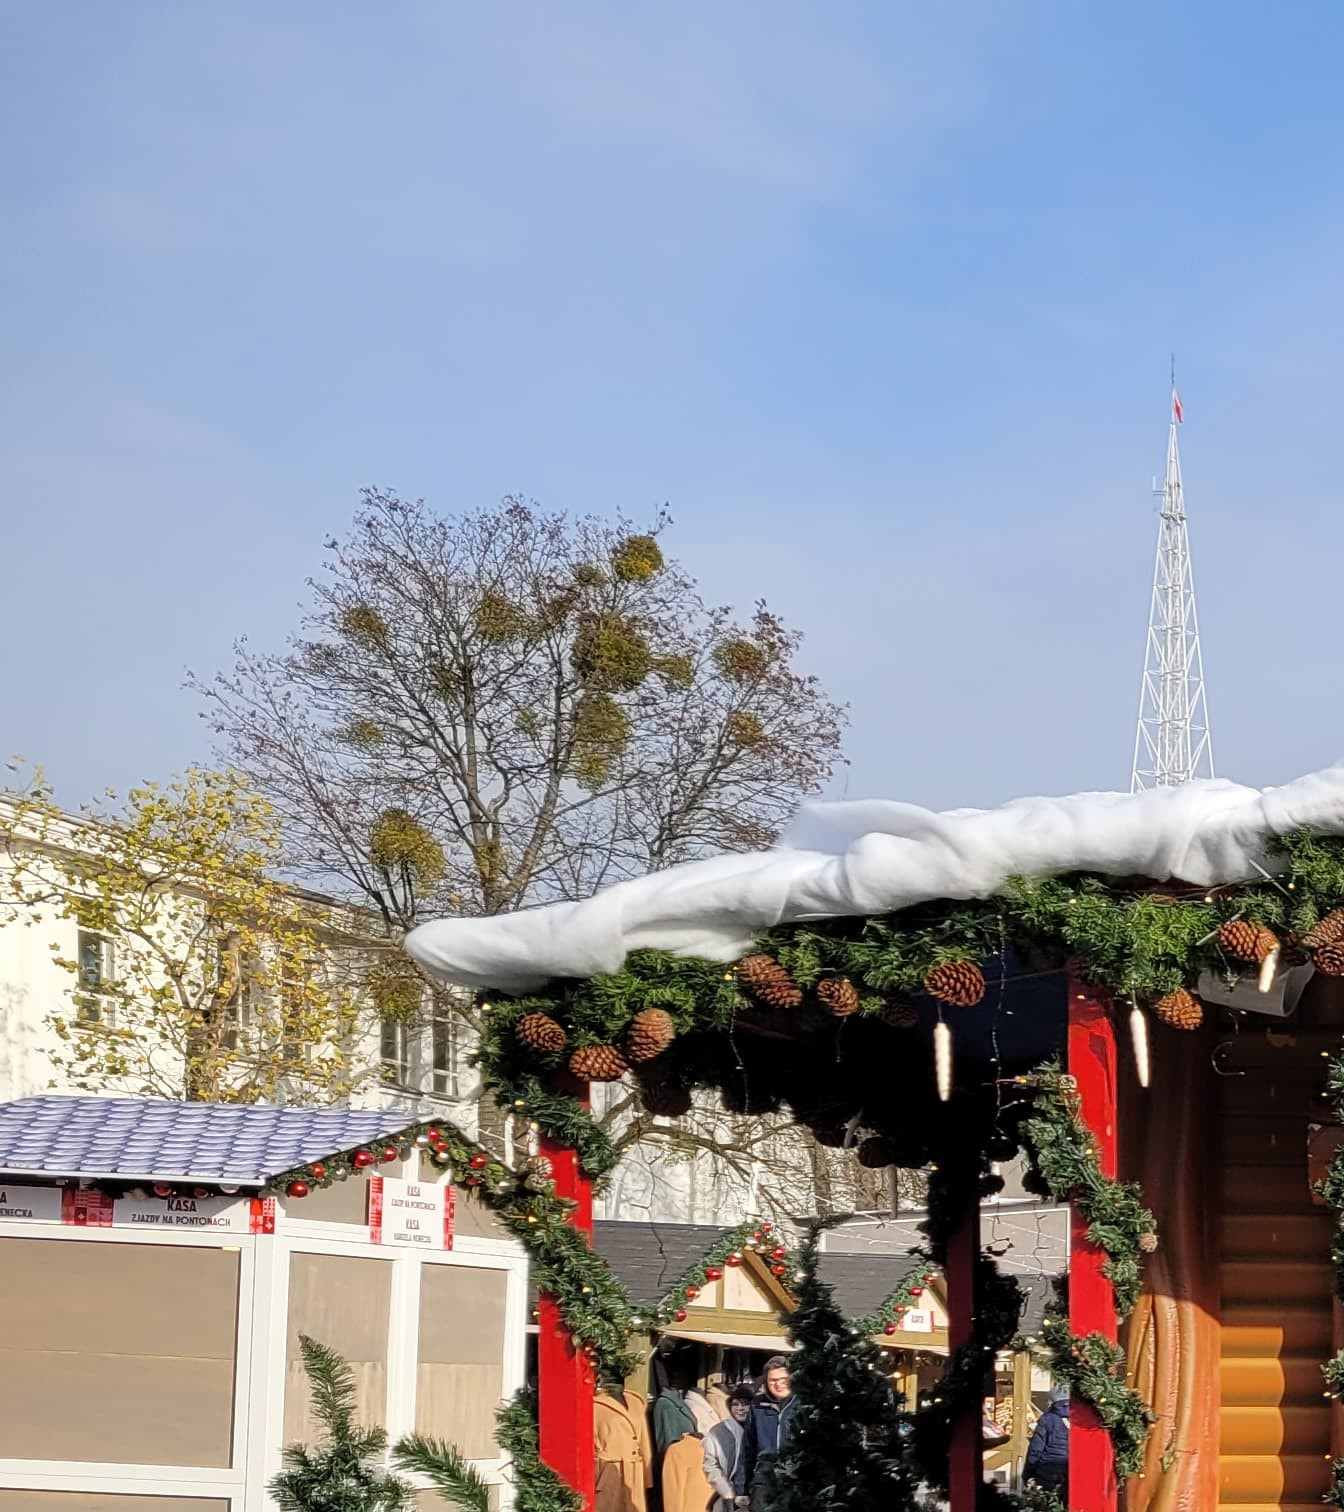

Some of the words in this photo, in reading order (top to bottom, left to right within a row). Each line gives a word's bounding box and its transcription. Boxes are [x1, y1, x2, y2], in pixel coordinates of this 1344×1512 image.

[167, 1199, 197, 1212] KASA
[132, 1213, 160, 1223] ZJAZDY
[162, 1215, 173, 1224] NA
[176, 1216, 231, 1227] PONTONACH
